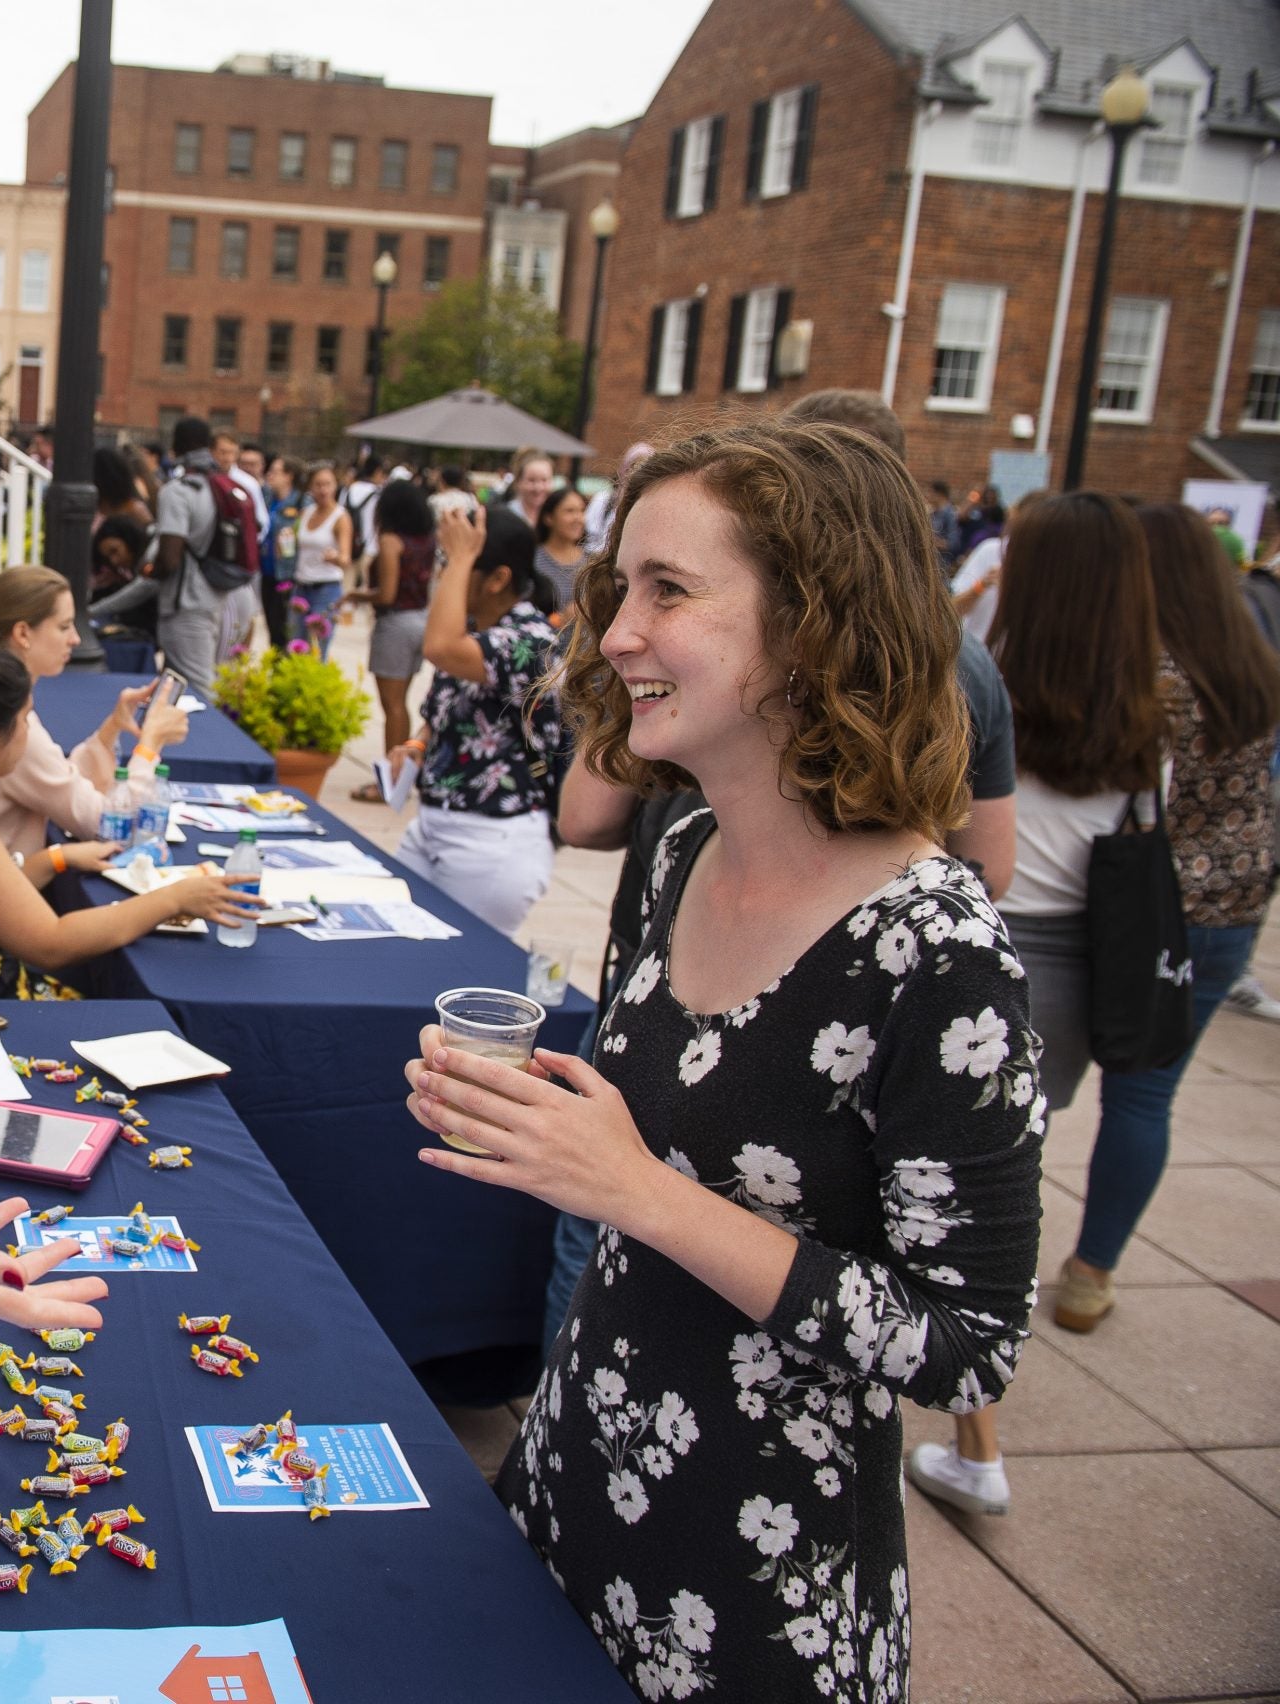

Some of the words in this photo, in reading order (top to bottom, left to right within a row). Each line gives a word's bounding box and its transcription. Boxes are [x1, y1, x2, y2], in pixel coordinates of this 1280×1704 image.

[74, 1439, 96, 1448] JOLLY
[319, 1435, 337, 1460] HOUR
[330, 1461, 351, 1491] HAPPY
[115, 1540, 138, 1555] JOLLY
